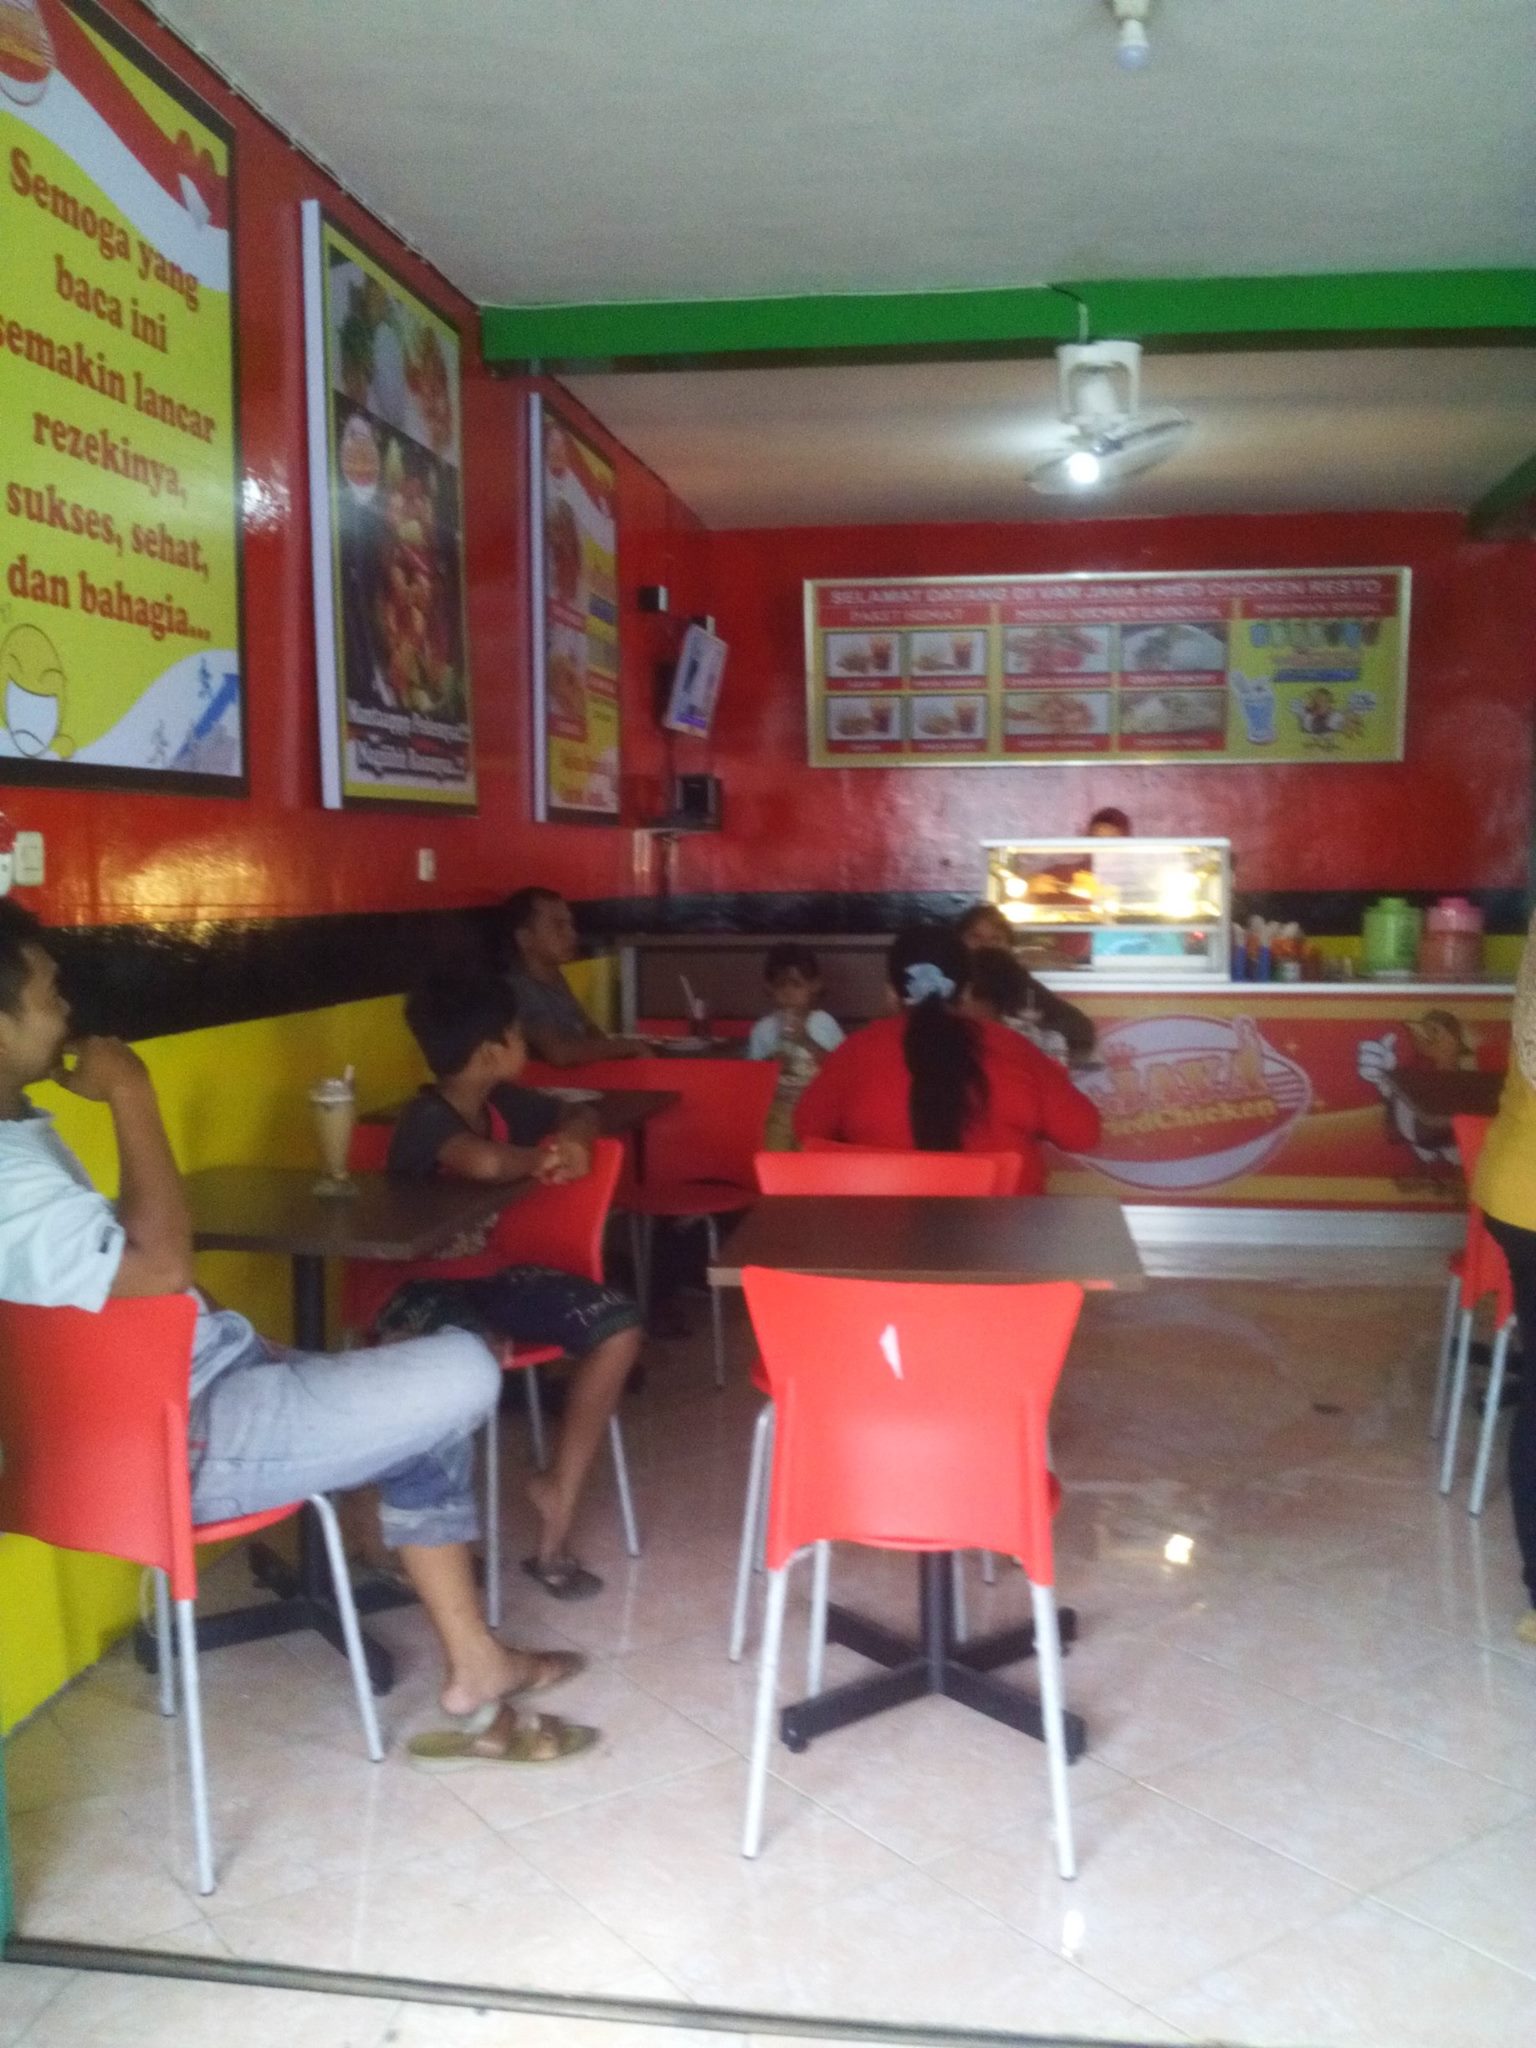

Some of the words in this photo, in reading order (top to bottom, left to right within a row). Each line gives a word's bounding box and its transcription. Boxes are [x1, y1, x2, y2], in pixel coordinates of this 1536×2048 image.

[10, 147, 131, 261] Semoga
[137, 240, 199, 312] yang
[55, 253, 123, 329] baca
[131, 297, 167, 353] ini
[133, 371, 216, 443] lancar
[33, 411, 188, 508] rezekinya,
[6, 481, 123, 557] sukses,
[131, 522, 209, 582] sehat,
[6, 554, 71, 609] dan
[830, 589, 922, 604] SELAMAT
[927, 588, 1006, 602] DATANG
[1012, 587, 1033, 600] DI
[1208, 581, 1302, 597] CHICKEN
[1308, 579, 1382, 596] RESTO
